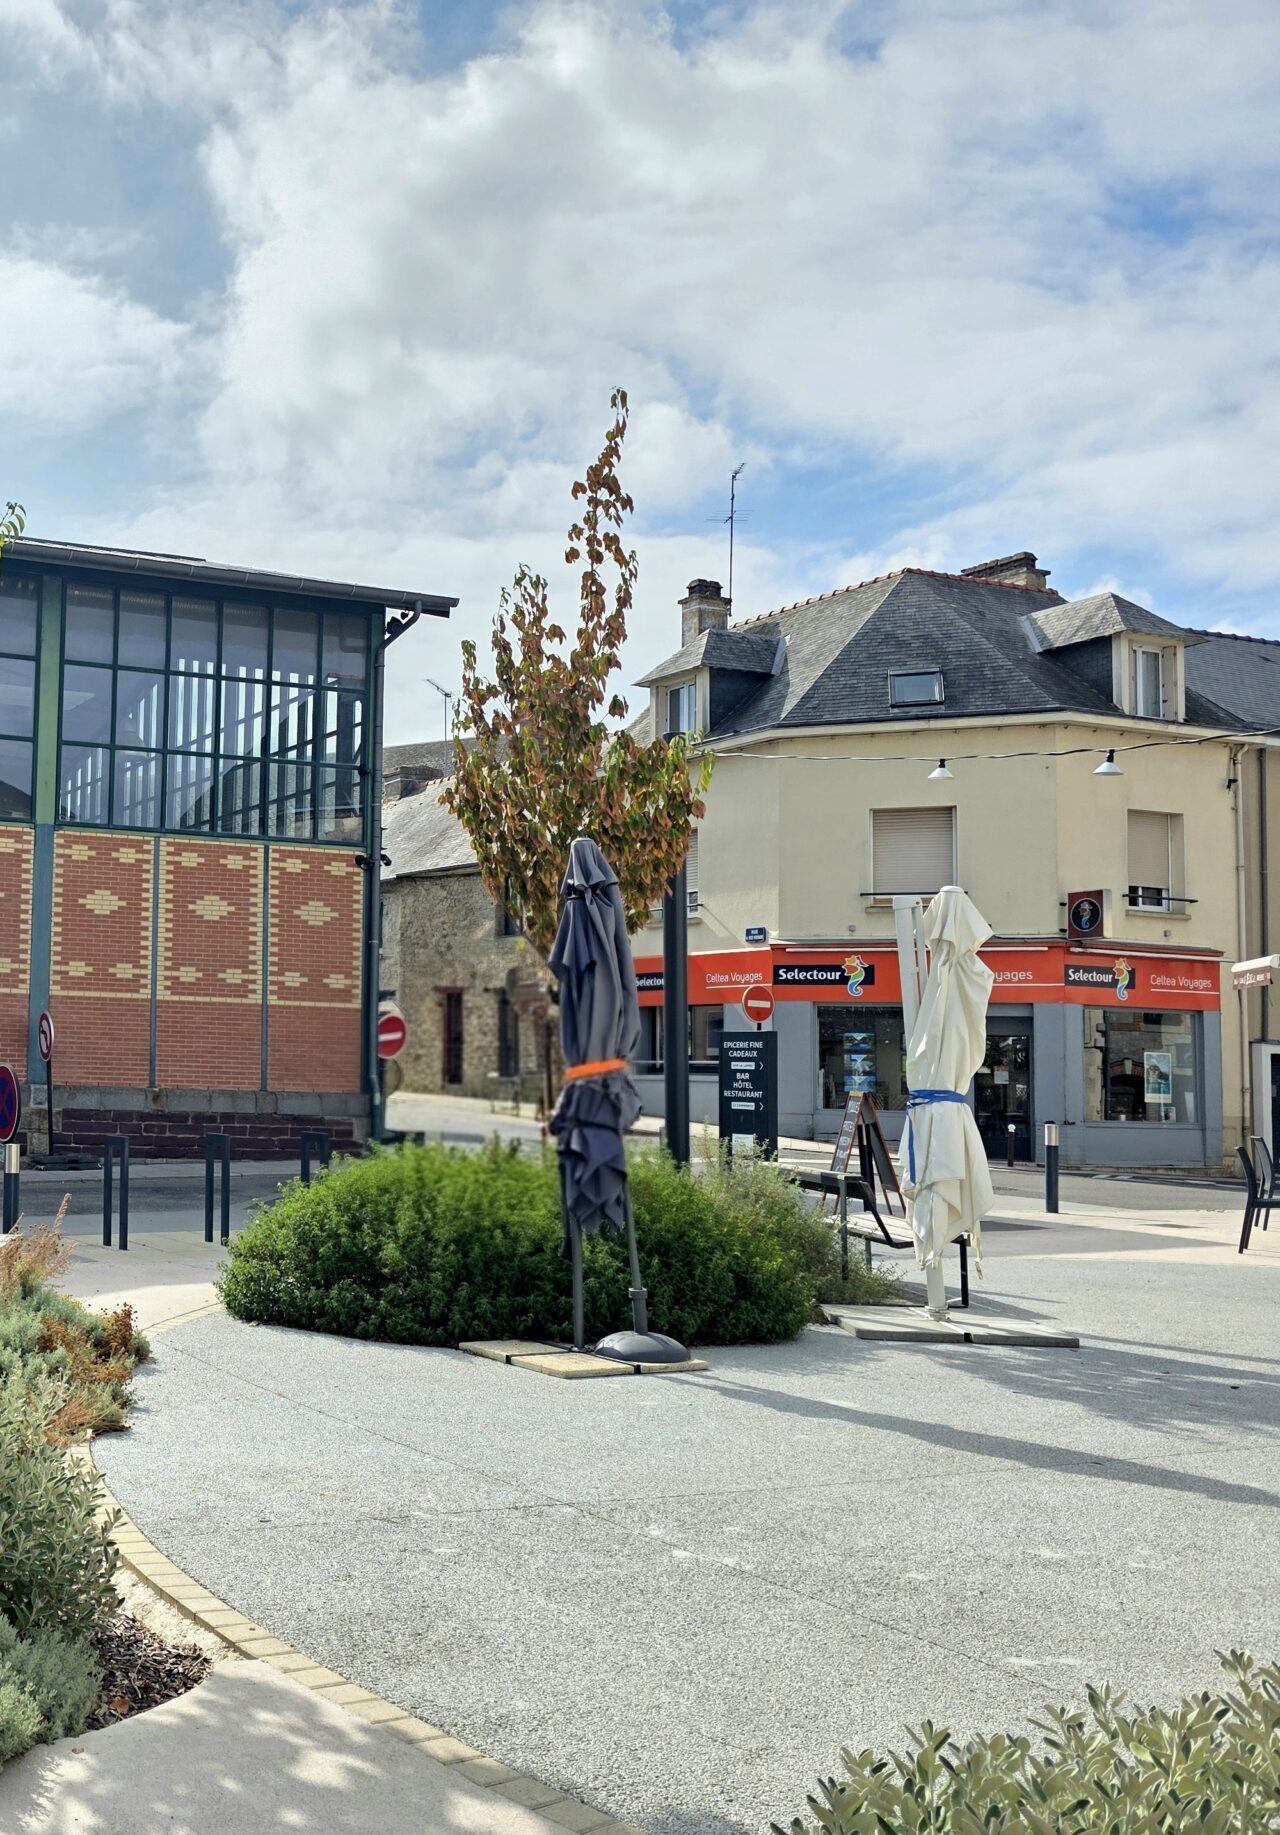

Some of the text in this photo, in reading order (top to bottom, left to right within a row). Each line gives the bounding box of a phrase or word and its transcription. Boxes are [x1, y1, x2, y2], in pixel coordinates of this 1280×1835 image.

[706, 972, 763, 984] Celtea Voyages
[778, 968, 841, 980] Selectour
[1068, 968, 1113, 982] Selectour
[1150, 974, 1212, 989] Celtea Voyages
[723, 1041, 763, 1049] EPICERIE FINE
[728, 1050, 758, 1058] CADEAUX
[736, 1072, 750, 1080] BAR
[733, 1079, 753, 1089] HÔTEL
[723, 1090, 763, 1098] RESTAURANT
